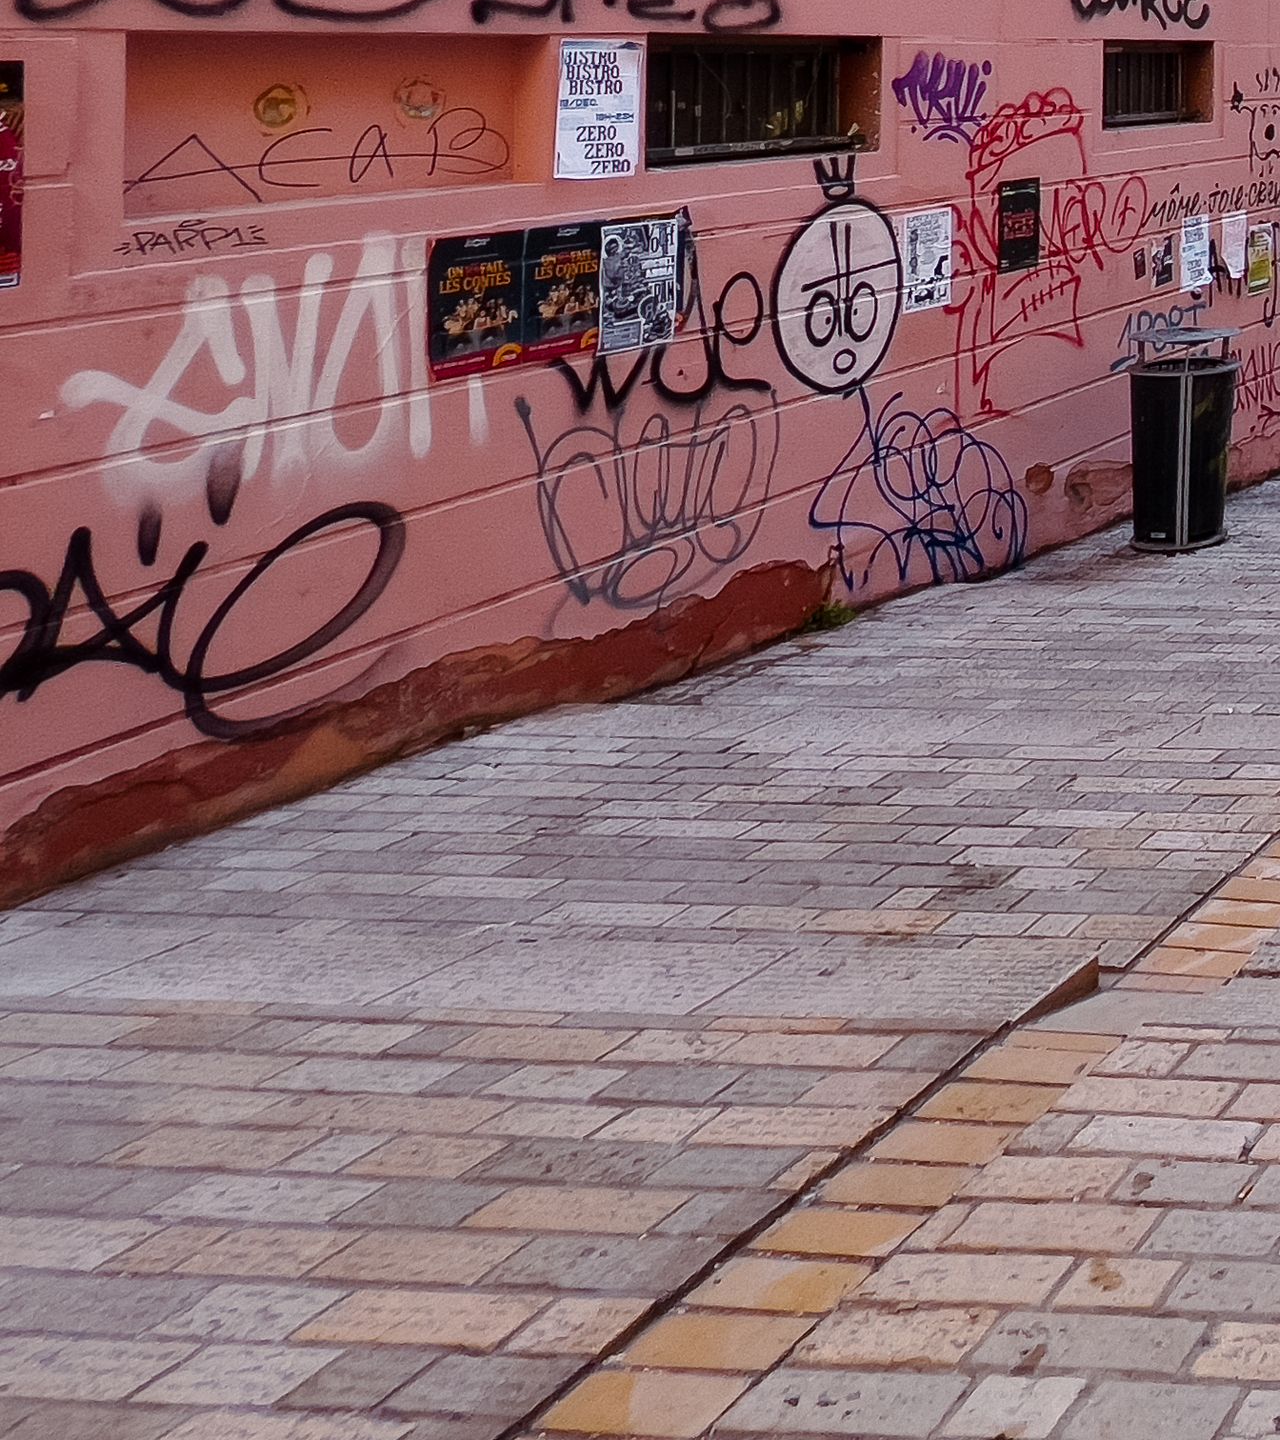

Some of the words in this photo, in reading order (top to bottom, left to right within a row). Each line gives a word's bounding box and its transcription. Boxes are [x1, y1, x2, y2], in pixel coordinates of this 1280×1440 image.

[563, 51, 617, 66] BISTRO
[565, 65, 620, 81] BISTRO
[568, 79, 623, 95] BISTRO
[576, 125, 617, 143] ZERO
[123, 107, 511, 203] ACAB
[584, 142, 625, 160] ZERO
[590, 159, 631, 175] ZERO
[534, 263, 554, 280] LES
[439, 277, 461, 295] LES
[463, 271, 512, 291] CONTES
